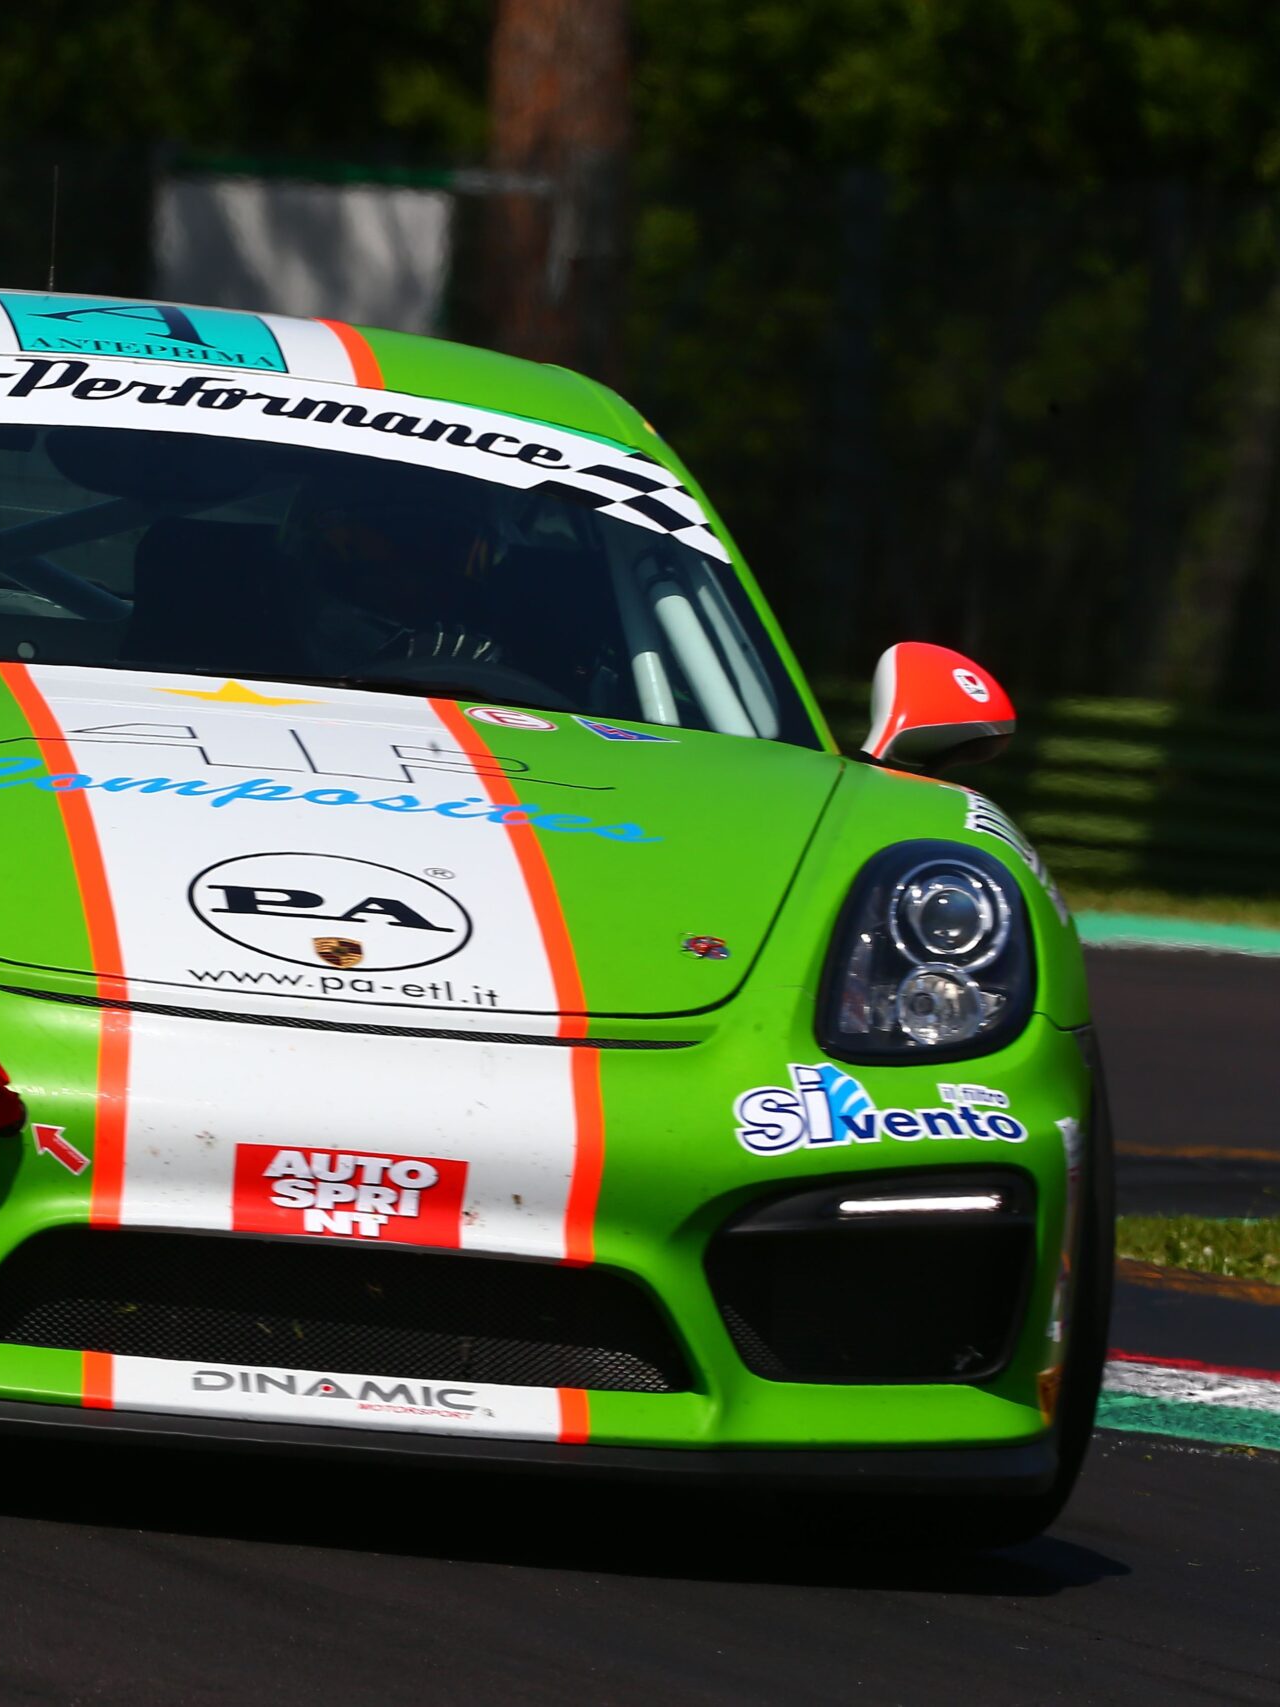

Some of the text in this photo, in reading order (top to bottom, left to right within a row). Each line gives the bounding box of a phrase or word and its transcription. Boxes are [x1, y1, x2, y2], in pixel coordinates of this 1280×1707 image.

[31, 337, 276, 367] ANTEPRIMA
[8, 358, 572, 470] Performance
[207, 885, 455, 932] PA
[187, 969, 500, 1007] www.pa-etl.it
[262, 1150, 439, 1189] AUTO
[269, 1179, 421, 1217] SPRI
[304, 1209, 389, 1237] NT
[192, 1370, 478, 1411] DINAMIC
[356, 1403, 474, 1420] MOTORSPORT
